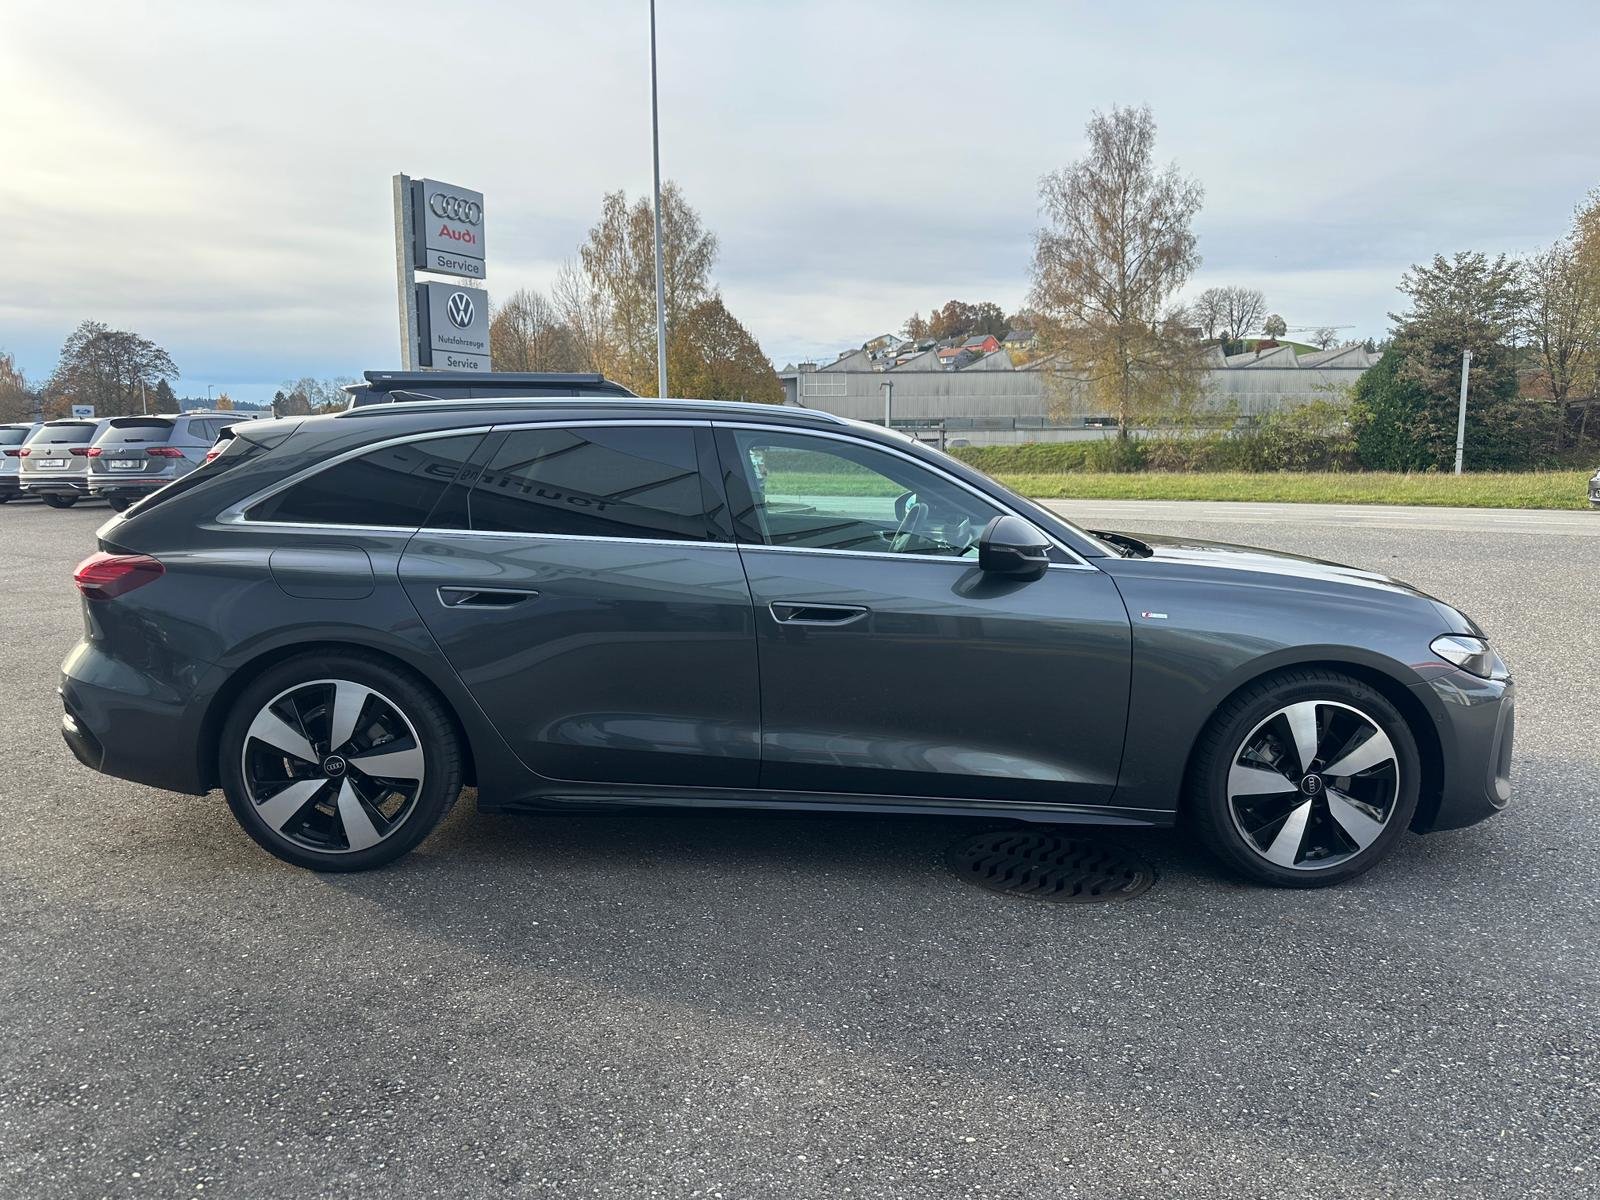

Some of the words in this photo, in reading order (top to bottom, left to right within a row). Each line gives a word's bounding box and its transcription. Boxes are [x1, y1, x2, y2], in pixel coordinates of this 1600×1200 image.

[438, 224, 476, 244] Audi
[437, 255, 479, 273] Service
[438, 334, 484, 349] Nutzfahrzeuge
[447, 356, 478, 370] Service
